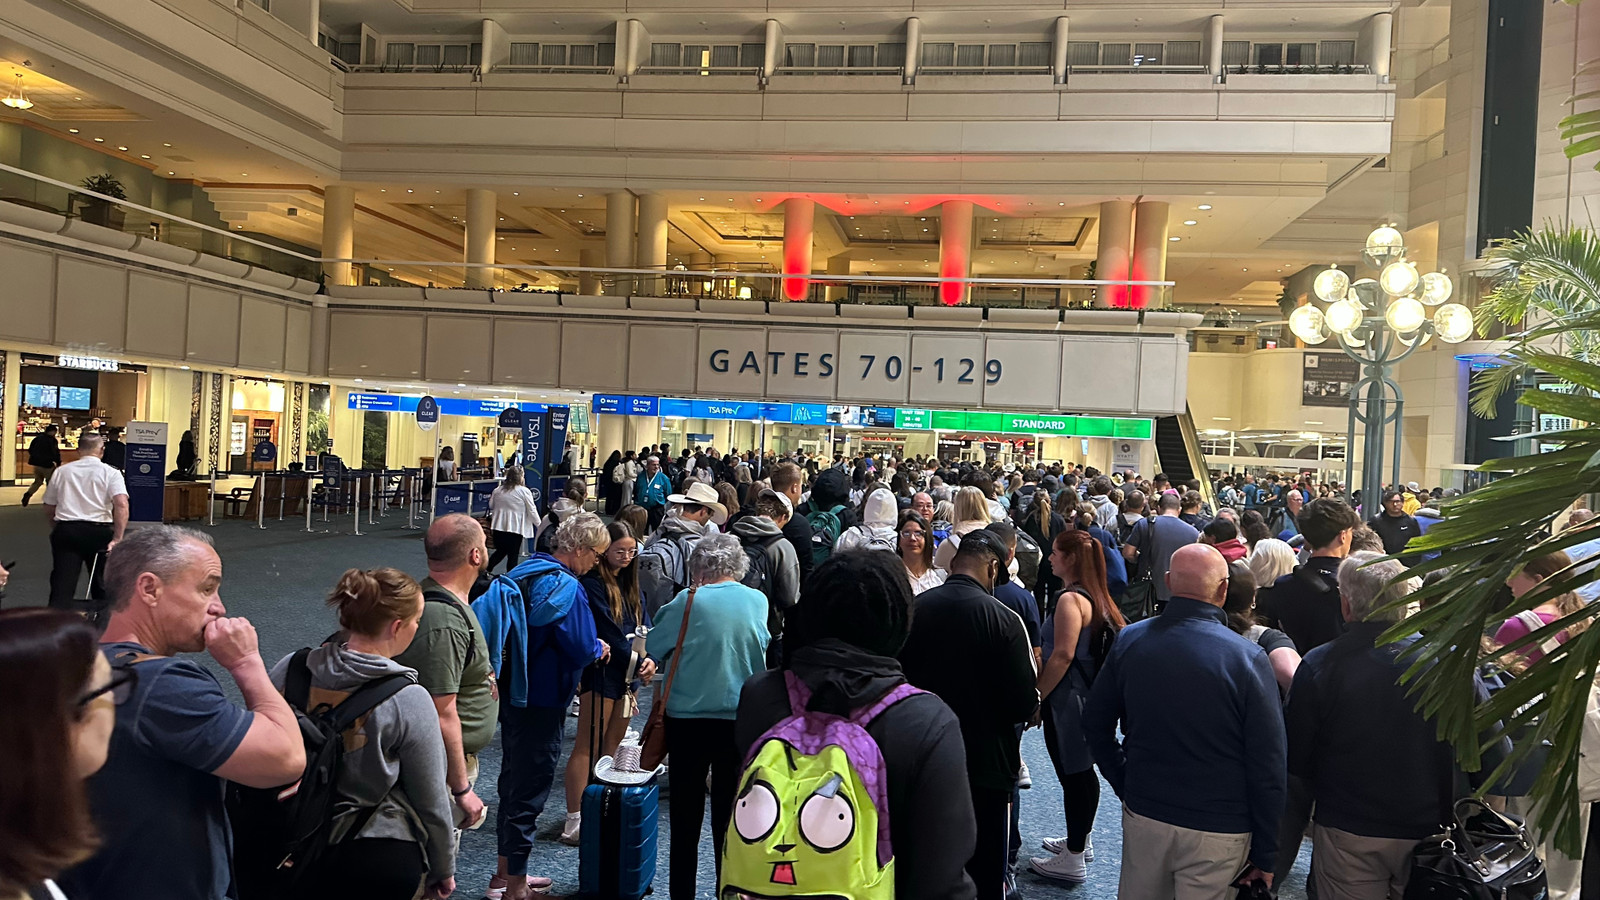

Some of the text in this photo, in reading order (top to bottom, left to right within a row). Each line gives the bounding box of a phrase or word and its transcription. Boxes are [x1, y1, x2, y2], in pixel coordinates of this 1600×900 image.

[58, 355, 119, 372] STARBUCKS
[709, 348, 1003, 384] GATES 70-129
[708, 406, 721, 414] TSA
[1012, 419, 1066, 430] STANDARD
[527, 416, 540, 462] TSA Pre
